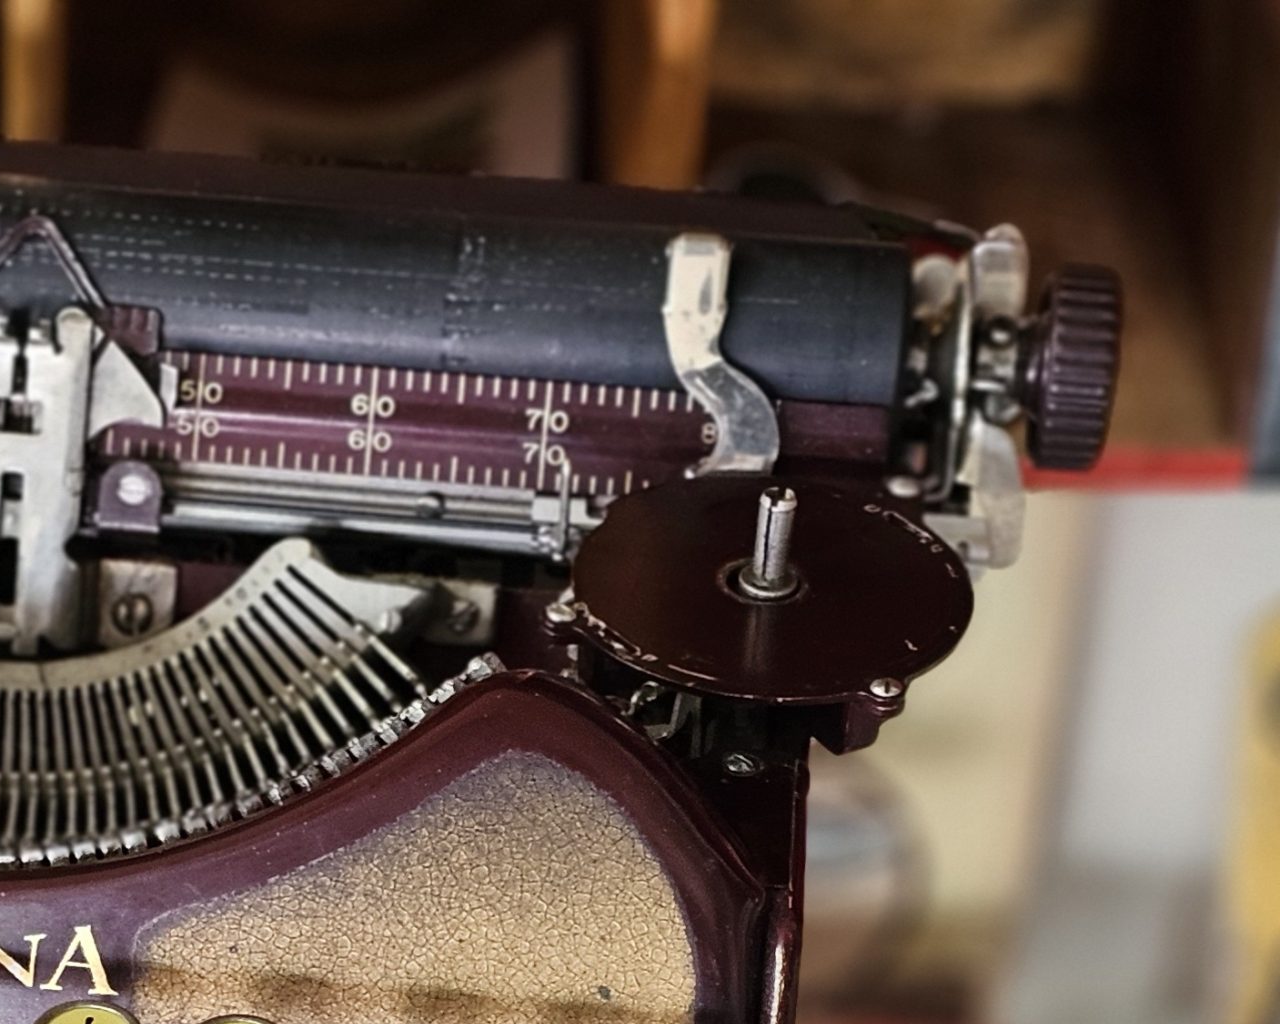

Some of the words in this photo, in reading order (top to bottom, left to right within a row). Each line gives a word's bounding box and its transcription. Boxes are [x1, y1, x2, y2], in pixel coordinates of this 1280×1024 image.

[179, 380, 223, 404] 50
[350, 393, 396, 418] 60
[175, 416, 220, 438] 50
[524, 408, 570, 433] 70
[347, 429, 393, 453] 60
[522, 442, 566, 466] 70
